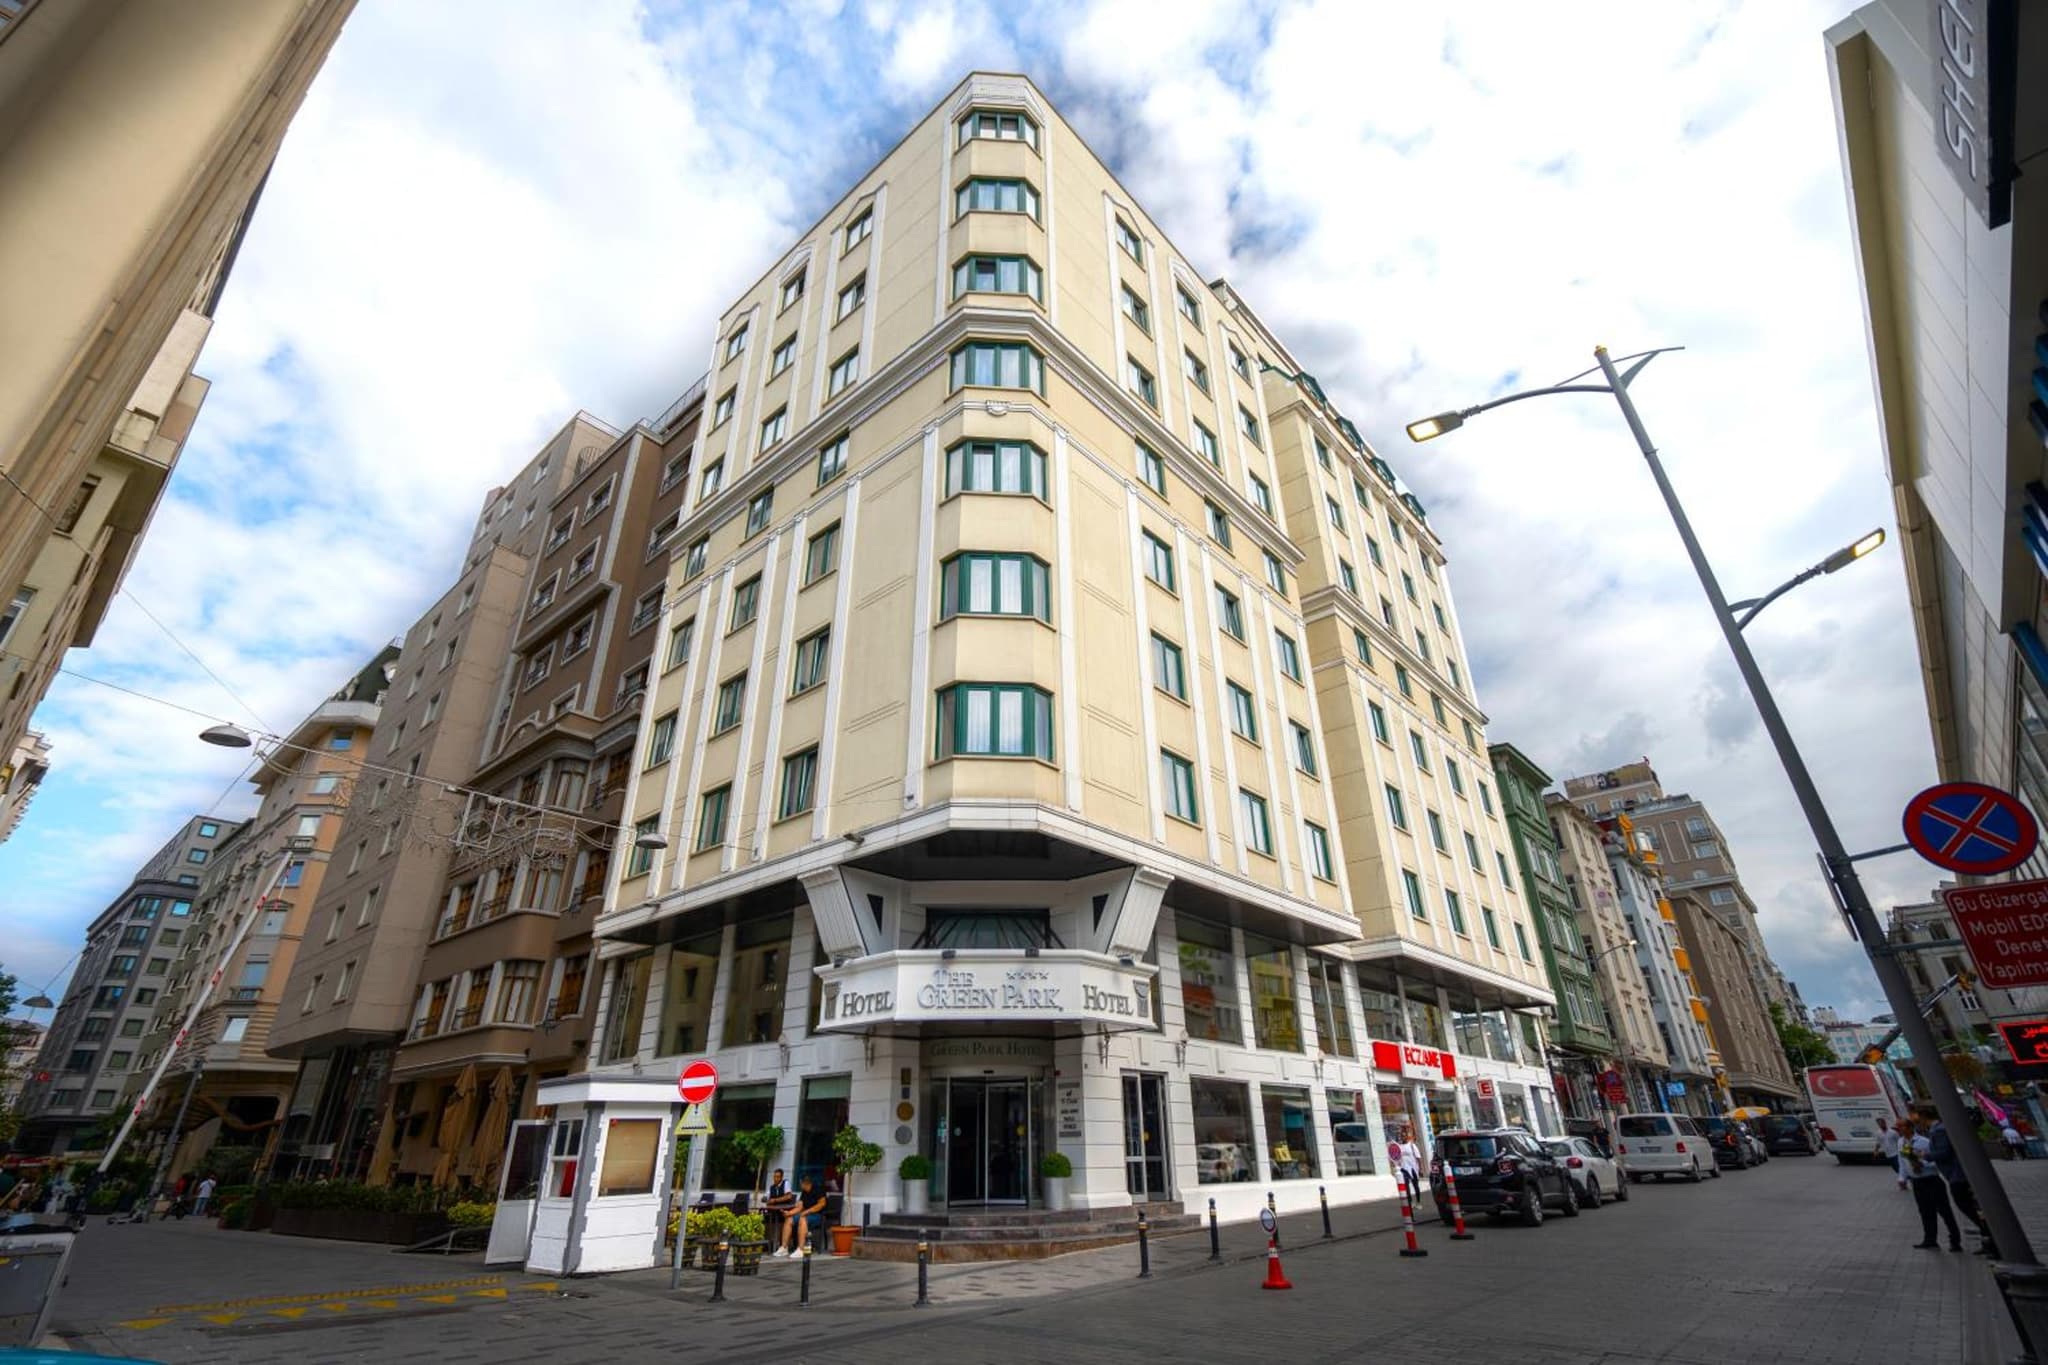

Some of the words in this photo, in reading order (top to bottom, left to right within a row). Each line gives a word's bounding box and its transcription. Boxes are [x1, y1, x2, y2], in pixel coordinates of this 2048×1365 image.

[1952, 896, 1978, 912] Bu
[1968, 916, 2018, 936] Mobil
[934, 969, 975, 987] THE
[841, 990, 895, 1018] HOTEL
[917, 984, 997, 1009] GREEN
[1002, 984, 1062, 1010] PARK
[1082, 984, 1134, 1017] HOTEL
[1008, 1041, 1043, 1056] HOTE
[1404, 1045, 1441, 1068] ECZANE
